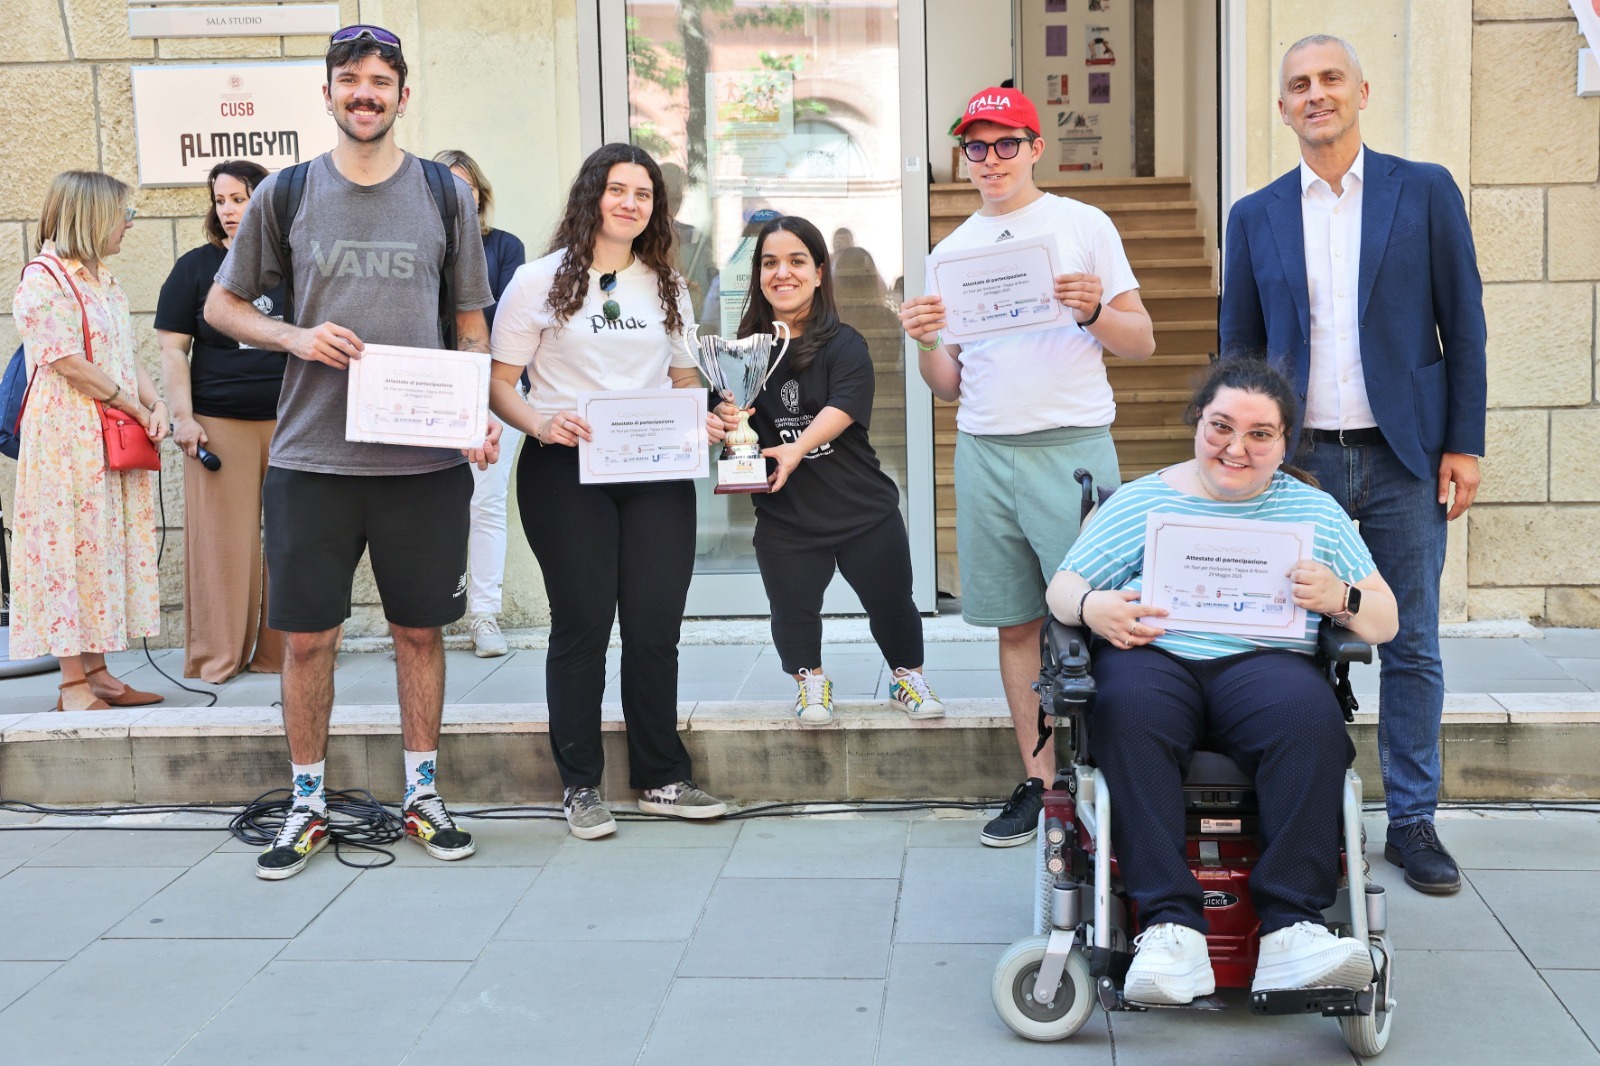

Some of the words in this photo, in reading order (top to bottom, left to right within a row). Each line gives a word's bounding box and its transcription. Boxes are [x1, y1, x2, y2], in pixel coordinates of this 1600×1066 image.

[206, 17, 226, 26] SALA
[228, 16, 262, 25] STUDIO
[220, 102, 254, 117] CUSB
[968, 94, 1011, 115] ITALIA
[180, 130, 300, 167] ALMAGYM
[310, 239, 418, 280] VANS
[991, 272, 1028, 283] partecipazione
[415, 380, 453, 389] partecipazione
[1222, 557, 1268, 565] partecipazione
